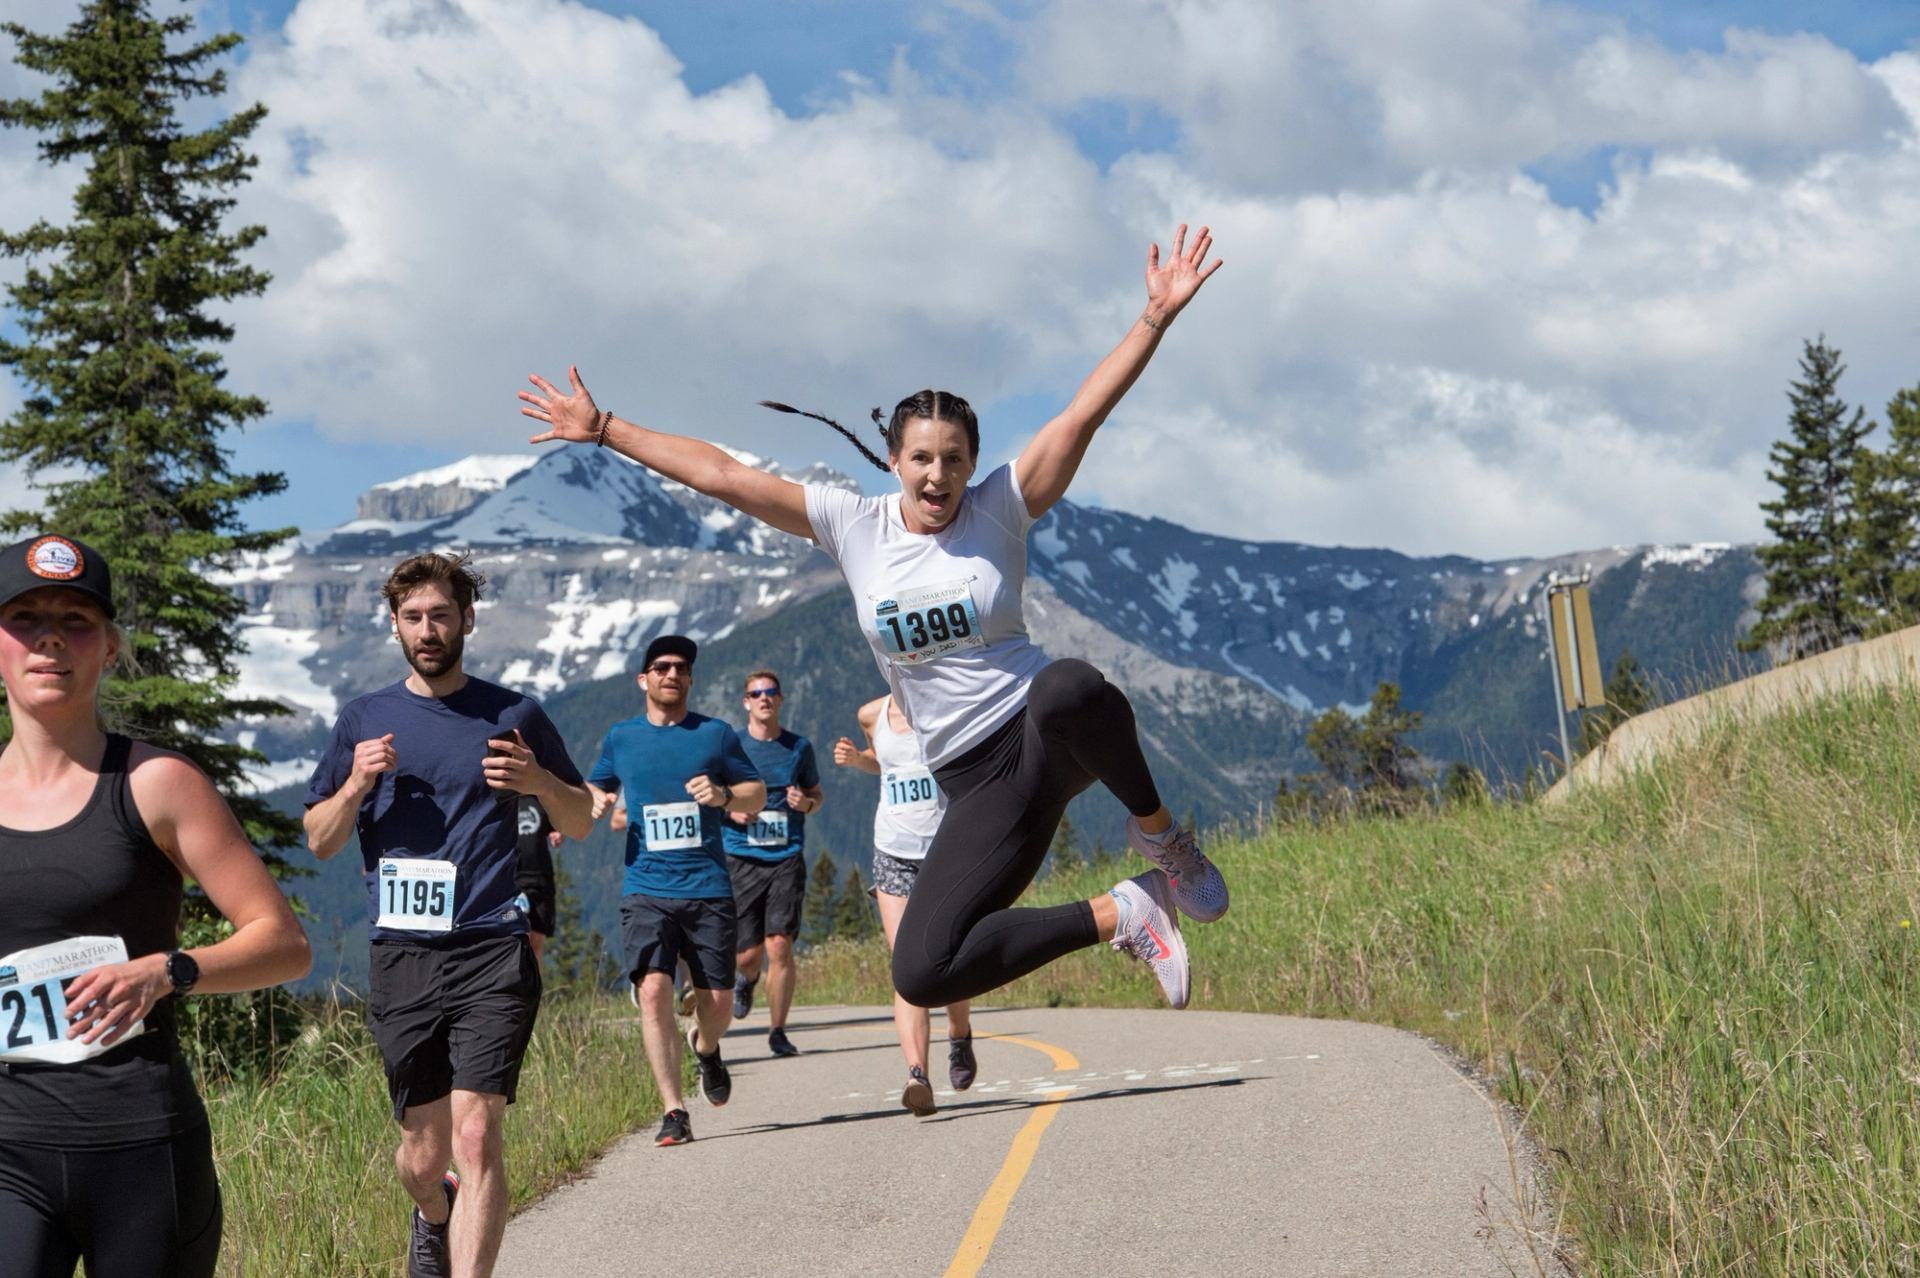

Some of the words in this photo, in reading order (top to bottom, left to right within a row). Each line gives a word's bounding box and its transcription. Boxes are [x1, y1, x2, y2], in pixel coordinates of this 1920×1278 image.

[886, 603, 971, 652] 1399
[891, 777, 932, 805] 1130
[651, 815, 696, 841] 1129
[387, 879, 446, 917] 1195
